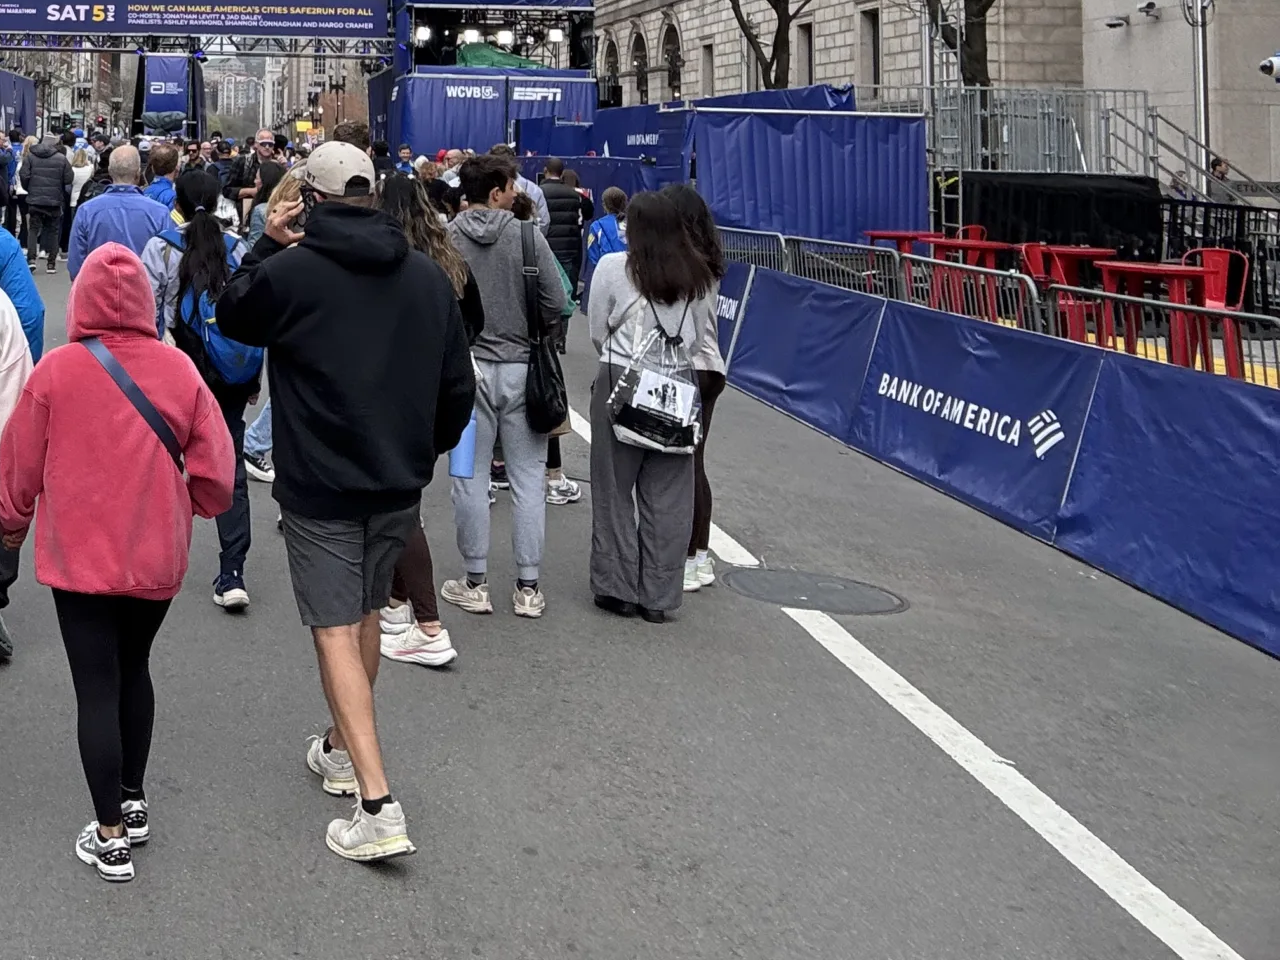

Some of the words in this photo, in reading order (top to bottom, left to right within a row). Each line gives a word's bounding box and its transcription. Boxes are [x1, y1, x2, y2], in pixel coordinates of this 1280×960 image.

[47, 4, 90, 21] SAT
[92, 5, 106, 22] 5
[106, 5, 116, 22] PM
[167, 5, 186, 13] CAN
[187, 5, 212, 13] MAKE
[213, 6, 260, 14] AMERICA'S
[261, 6, 288, 14] CITIES
[290, 6, 336, 15] SAFE2RUN
[337, 7, 356, 16] FOR
[357, 8, 374, 16] ALL
[345, 22, 374, 30] CRAMER
[446, 86, 481, 97] WCVB
[513, 87, 562, 102] ESPN
[878, 372, 923, 408] BANK
[922, 388, 944, 415] OF
[940, 395, 1021, 447] AMERICA
